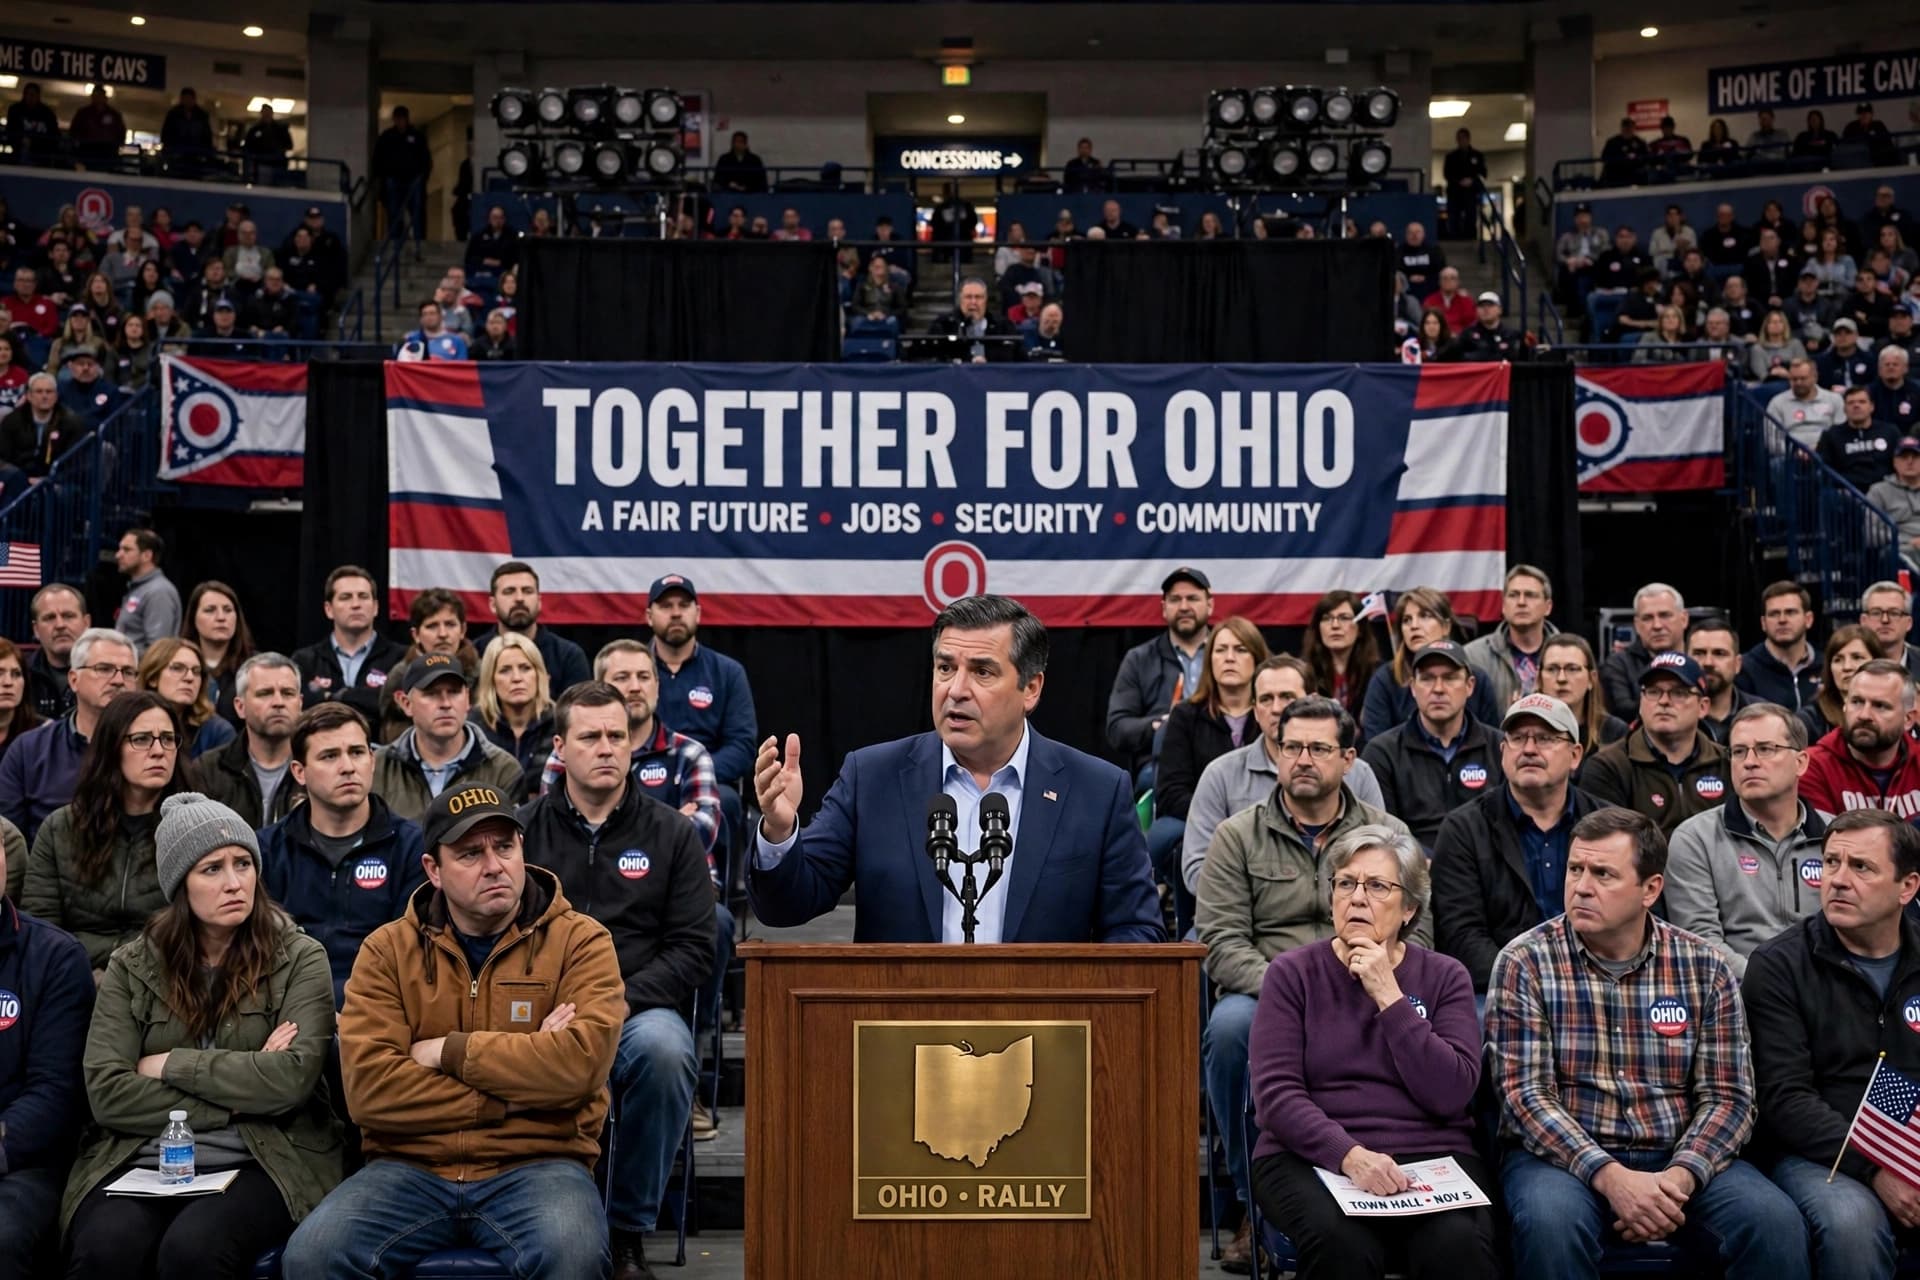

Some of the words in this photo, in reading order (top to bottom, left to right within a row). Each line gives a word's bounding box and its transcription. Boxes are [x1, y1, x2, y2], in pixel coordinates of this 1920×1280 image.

[31, 48, 55, 73] OF
[61, 51, 95, 77] THE
[101, 55, 147, 83] CAVS
[1717, 70, 1781, 107] HOME
[1788, 67, 1816, 100] OF
[1823, 63, 1866, 97] THE
[1873, 57, 1920, 92] CAV
[900, 150, 1002, 170] CONCESSIONS
[542, 387, 957, 489] TOGETHER
[986, 389, 1138, 490] FOR
[1164, 389, 1354, 489] OHIO
[581, 500, 604, 531] A
[612, 501, 680, 532] FAIR
[690, 502, 808, 533] FUTURE
[841, 502, 921, 534] JOBS
[955, 503, 1103, 534] SECURITY
[1136, 502, 1321, 534] COMMUNITY
[1460, 768, 1487, 782] OHIO
[449, 788, 499, 815] OHIO
[355, 865, 387, 879] OHIO
[618, 857, 649, 870] OHIO
[1651, 1006, 1687, 1023] OHIO
[878, 1184, 948, 1208] OHIO
[978, 1184, 1067, 1208] RALLY
[1349, 1201, 1388, 1210] TOWN
[1390, 1198, 1424, 1209] HALL
[1433, 1193, 1461, 1204] NOV
[1464, 1191, 1473, 1200] 5
